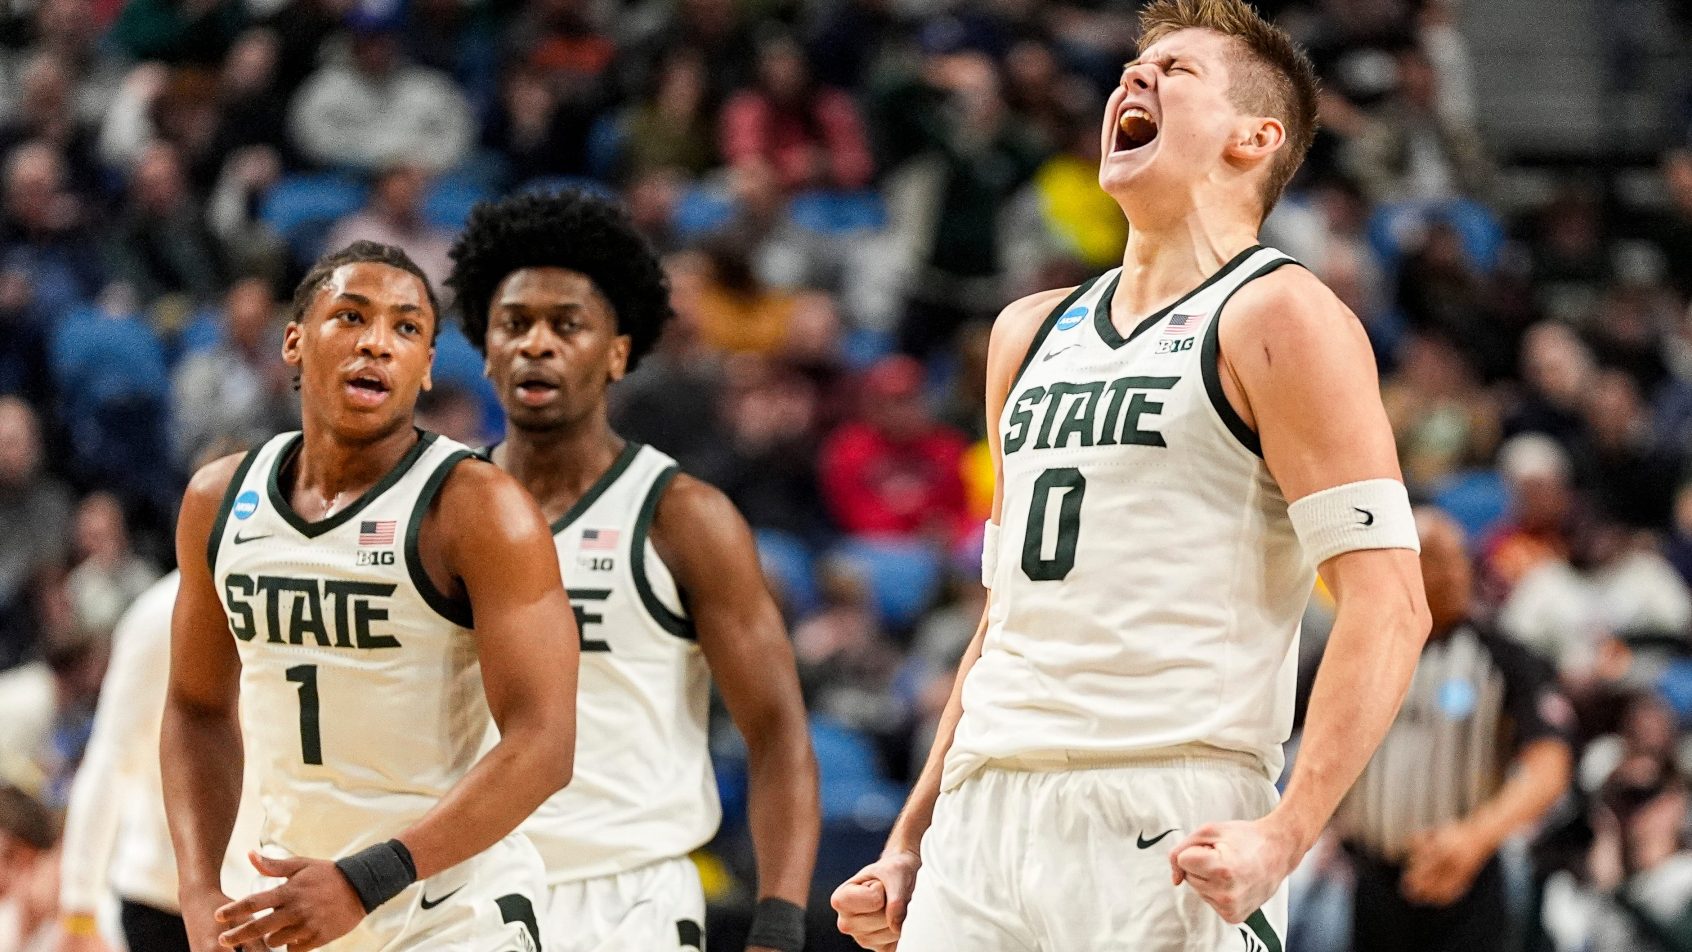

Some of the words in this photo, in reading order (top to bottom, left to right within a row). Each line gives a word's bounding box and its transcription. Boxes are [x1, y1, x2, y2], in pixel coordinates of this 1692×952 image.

[1004, 376, 1182, 455] STATE
[1021, 467, 1086, 581] 0
[225, 573, 402, 649] STATE
[285, 664, 323, 765] 1
